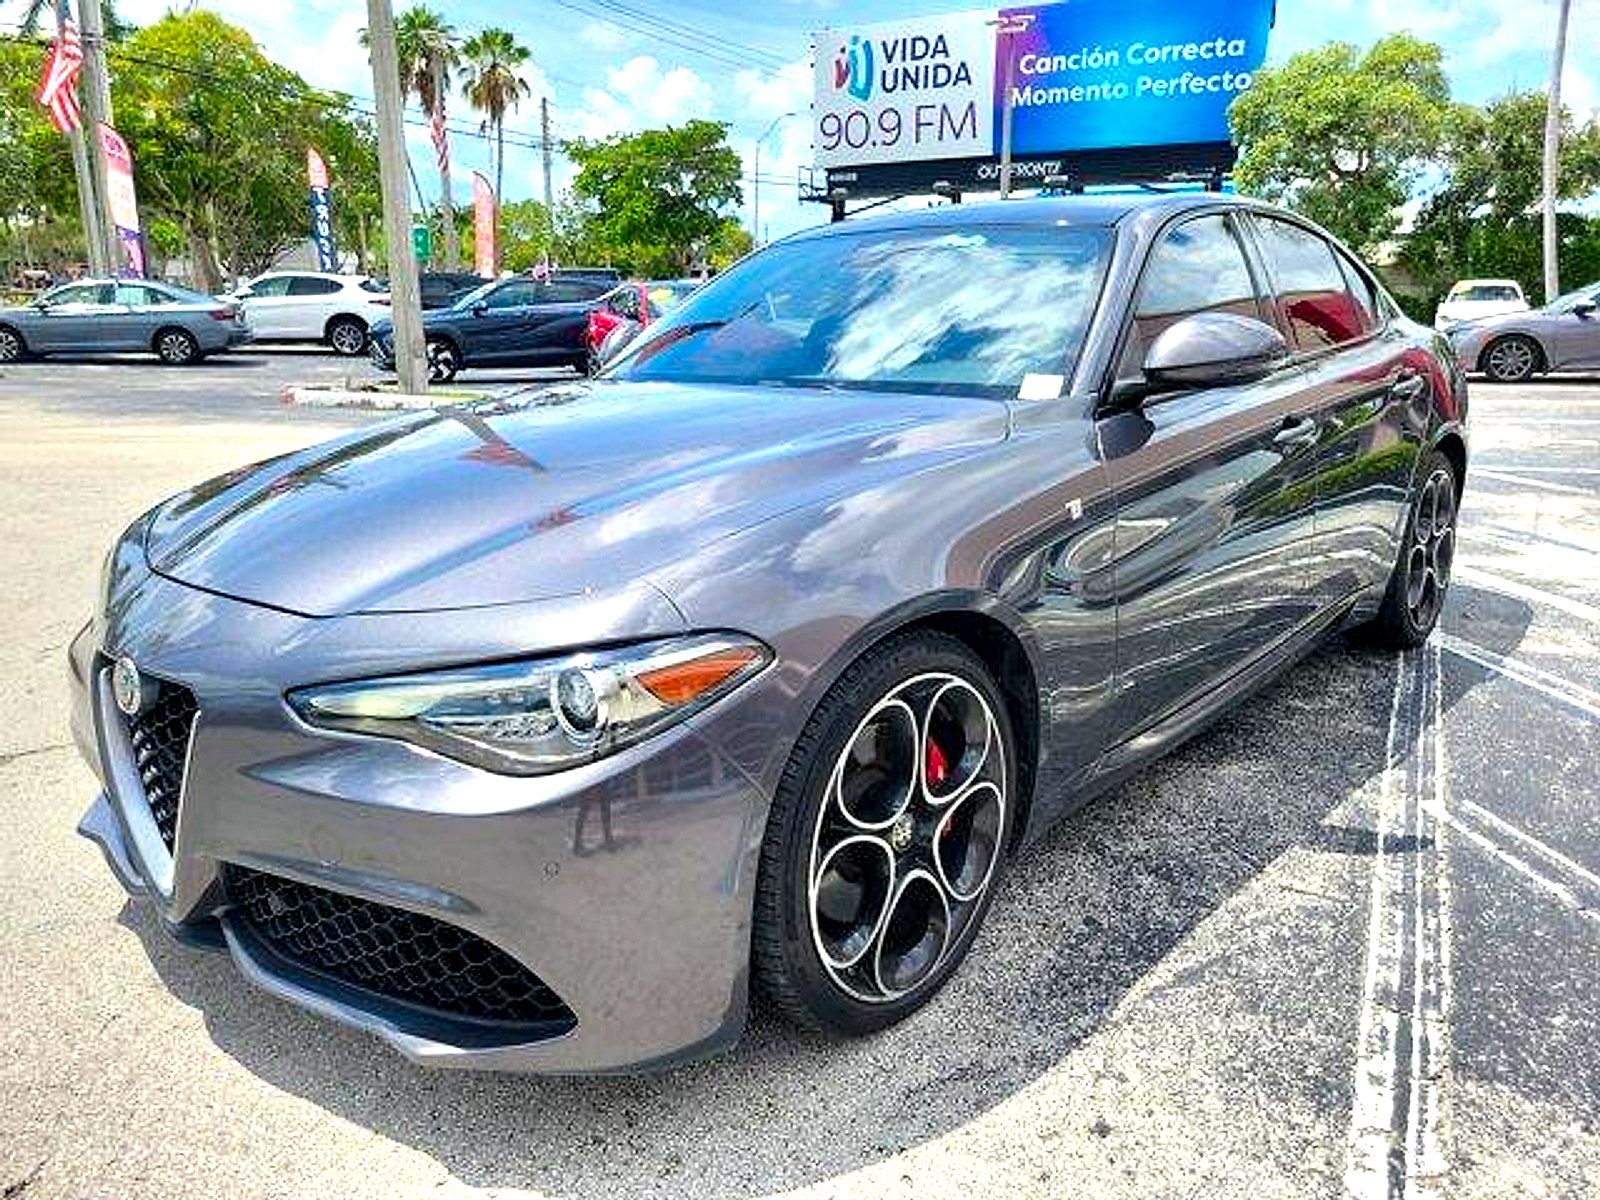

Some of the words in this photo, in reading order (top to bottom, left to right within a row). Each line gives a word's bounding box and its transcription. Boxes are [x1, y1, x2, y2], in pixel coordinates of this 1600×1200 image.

[881, 33, 950, 63] VIDA
[1019, 47, 1120, 74] Canción
[1126, 37, 1246, 65] Correcta
[881, 61, 972, 93] UNIDA
[1011, 81, 1129, 107] Momento
[1135, 70, 1252, 98] Perfecto
[820, 107, 902, 150] 90.9
[915, 100, 977, 144] FM
